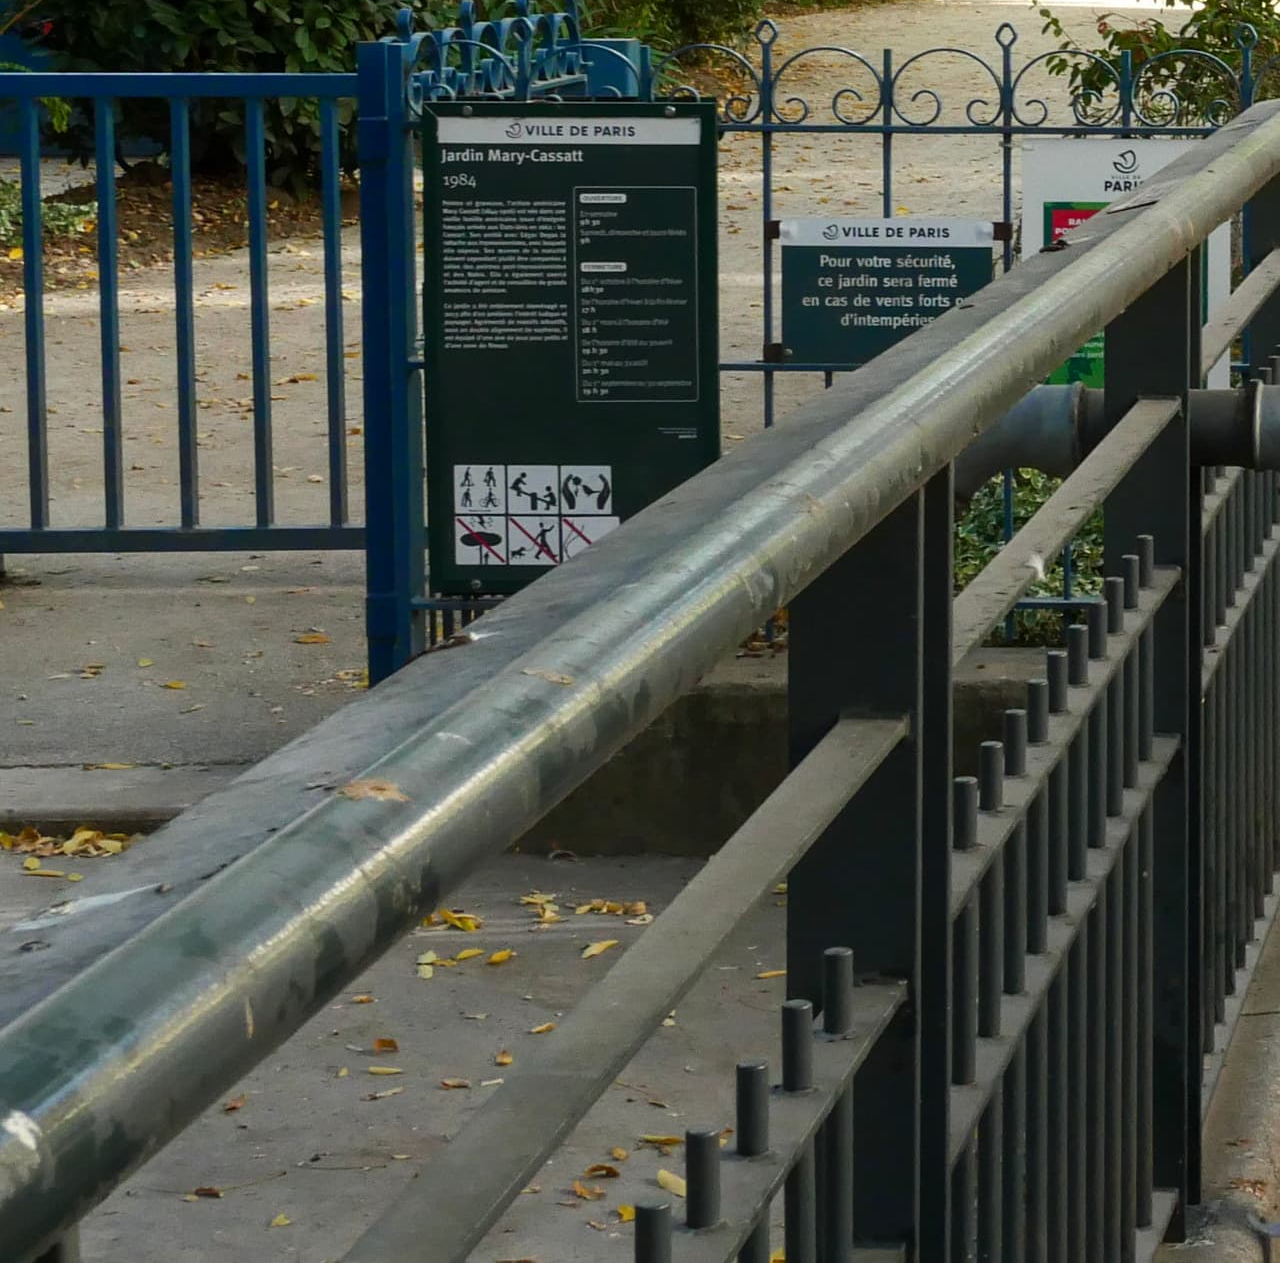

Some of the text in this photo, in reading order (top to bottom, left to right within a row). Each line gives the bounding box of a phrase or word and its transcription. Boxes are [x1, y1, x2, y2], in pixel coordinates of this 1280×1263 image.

[525, 125, 637, 137] VILLE DE PARIS
[441, 149, 584, 166] Jardin Mary-Cassatt
[442, 172, 477, 188] 1984
[842, 227, 950, 238] VILLE DE PARIS
[819, 254, 956, 270] Pour votre sécurité,
[818, 274, 958, 289] ce jardin sera fermé
[802, 296, 819, 307] en
[824, 296, 849, 307] cas
[853, 294, 871, 307] de
[876, 295, 914, 307] vents
[918, 294, 951, 307] forts
